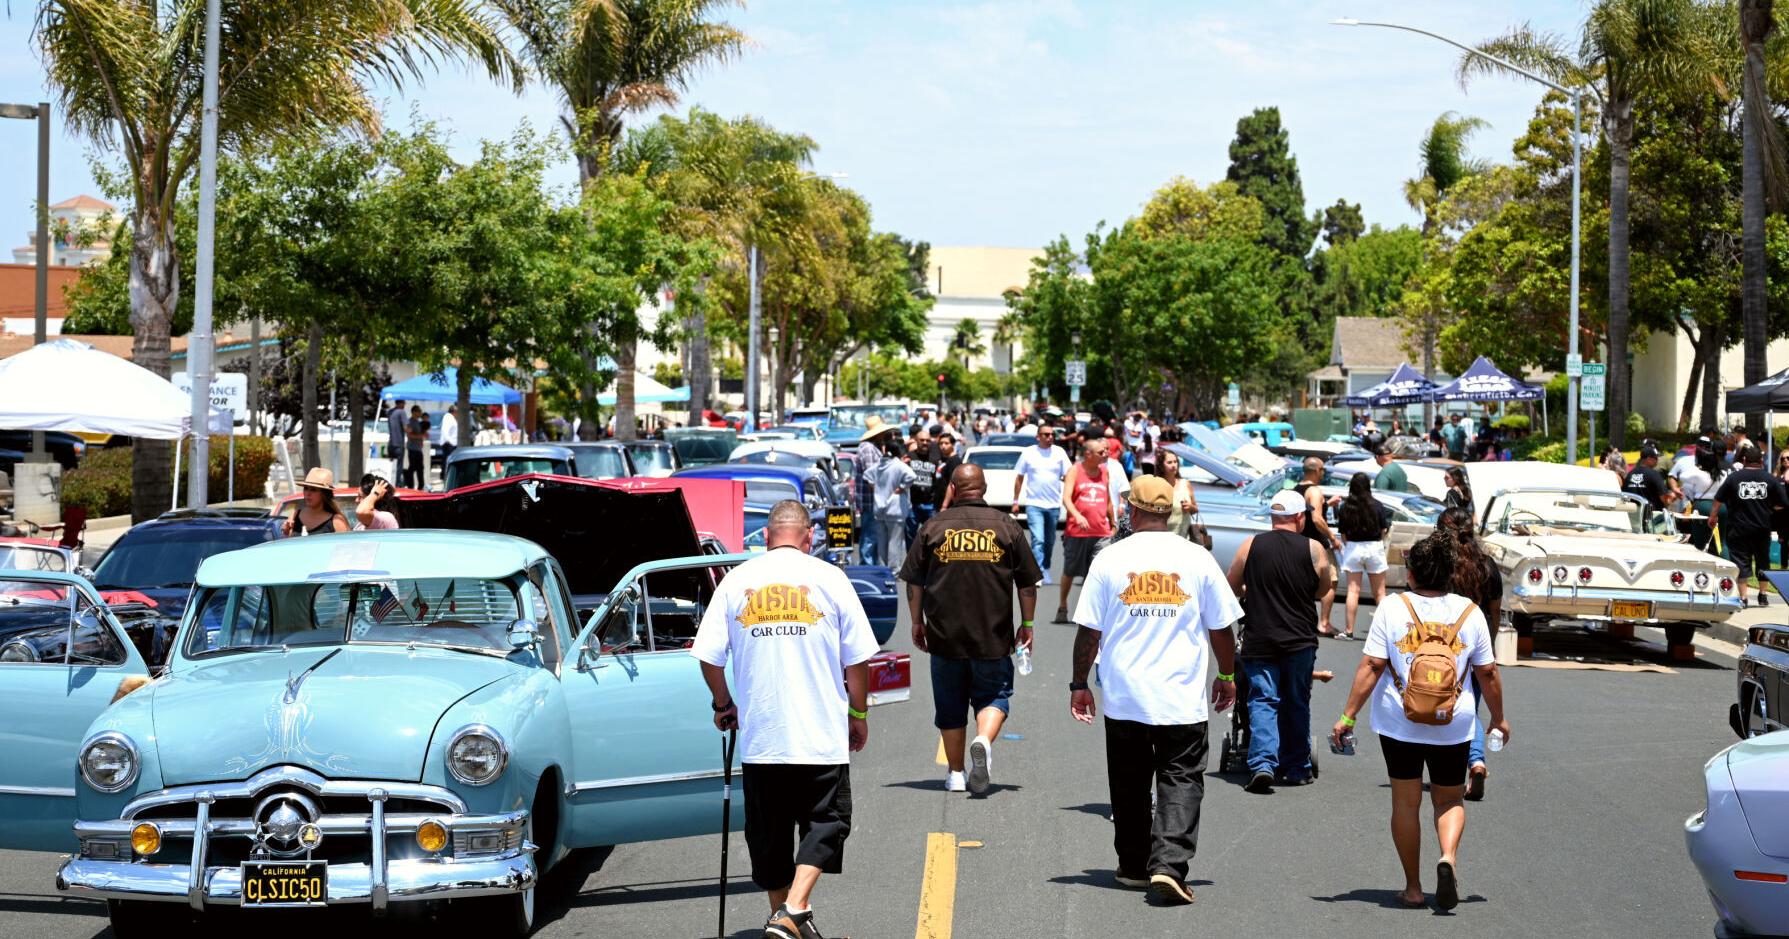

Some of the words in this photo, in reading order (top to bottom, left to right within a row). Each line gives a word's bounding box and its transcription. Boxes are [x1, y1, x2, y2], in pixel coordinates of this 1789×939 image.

[1584, 365, 1603, 374] BEGIN
[1068, 374, 1084, 384] 25
[1130, 608, 1149, 617] CAR
[1151, 608, 1177, 617] CLUB
[751, 627, 773, 638] CAR
[775, 626, 807, 636] CLUB
[263, 867, 306, 875] CALIFORNIA
[247, 878, 320, 899] CLSIC50
